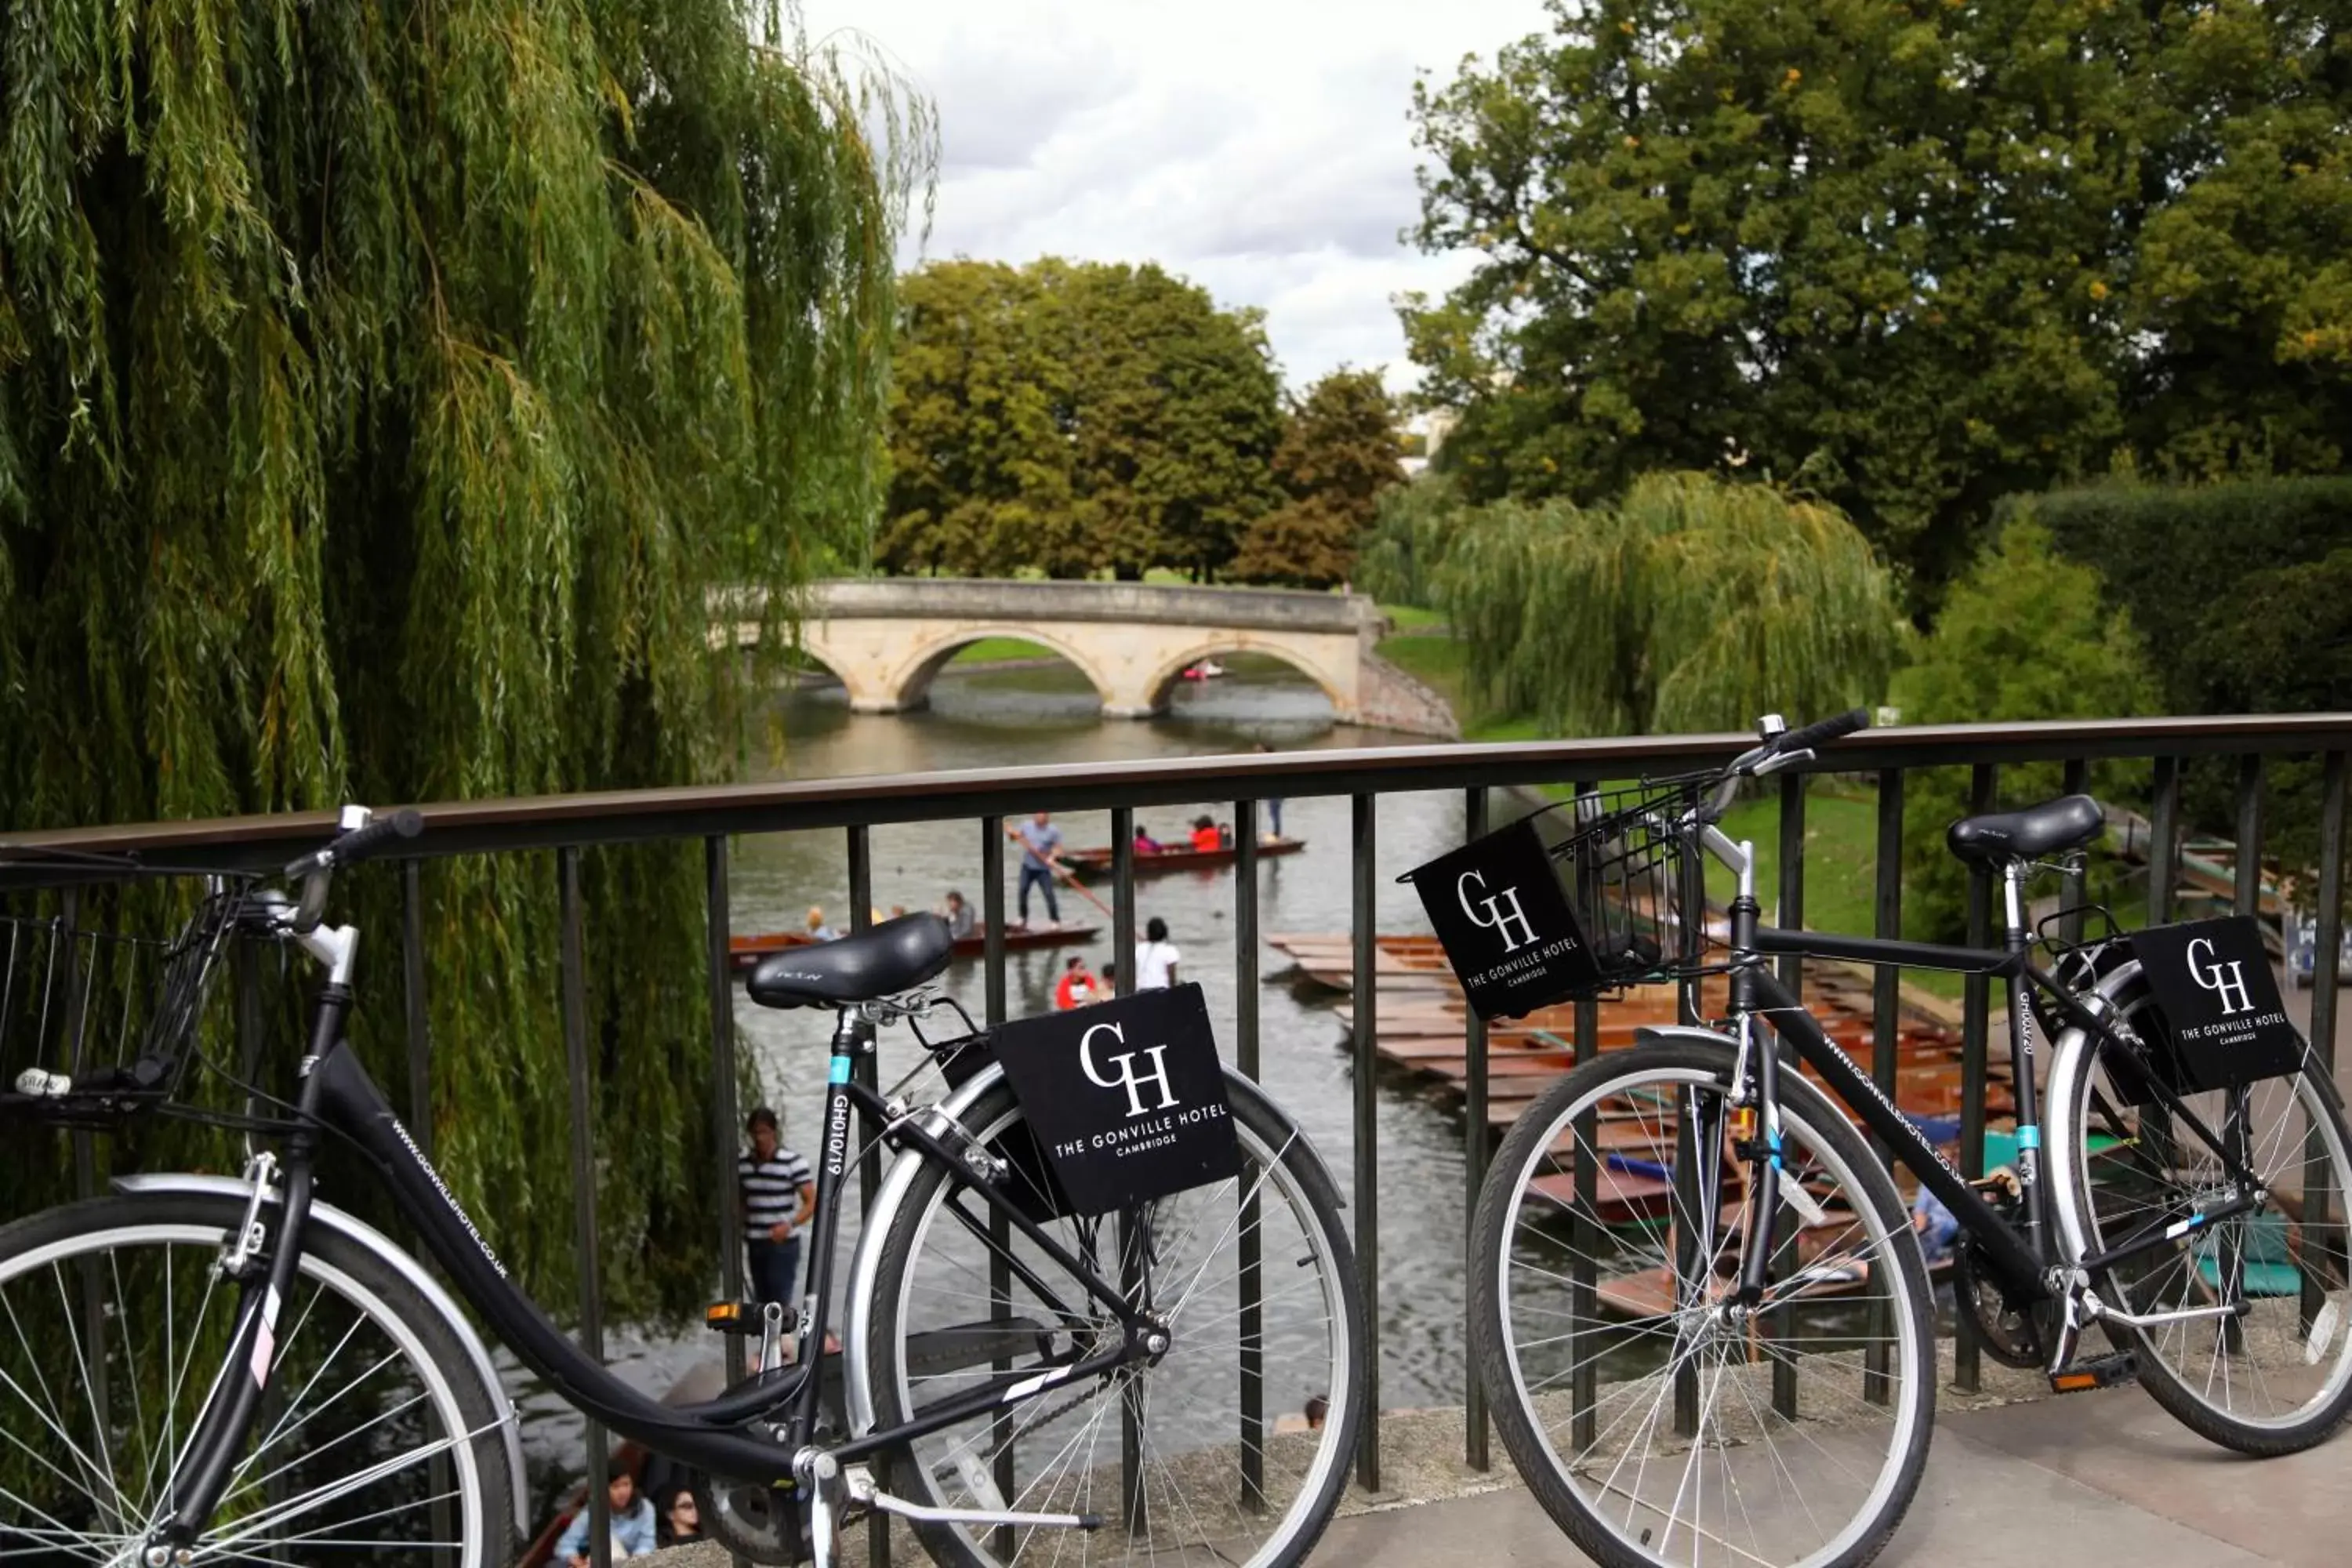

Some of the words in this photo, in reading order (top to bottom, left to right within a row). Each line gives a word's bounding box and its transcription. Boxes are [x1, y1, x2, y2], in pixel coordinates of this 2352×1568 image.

[1457, 869, 1541, 953] GH
[1467, 973, 1487, 989] THE
[1489, 950, 1541, 981] GONVILLE
[1542, 937, 1578, 960] HOTEL
[1507, 966, 1548, 988] CAMBRIDGE
[2187, 938, 2256, 1015] GH
[2181, 1029, 2201, 1040] THE
[2203, 1018, 2253, 1037] GONVILLE
[2255, 1012, 2285, 1026] HOTEL
[2220, 1032, 2256, 1045] CAMBRIDGE
[1080, 1022, 1180, 1118] GH
[828, 1094, 848, 1175] GH010/19
[1055, 1139, 1085, 1159] THE
[1091, 1116, 1173, 1149] GONVILLE
[1178, 1103, 1228, 1126] HOTEL
[1116, 1134, 1177, 1157] CAMBRIDGE
[393, 1119, 508, 1279] WWW.GONVILLEHOTEL.CO.UK
